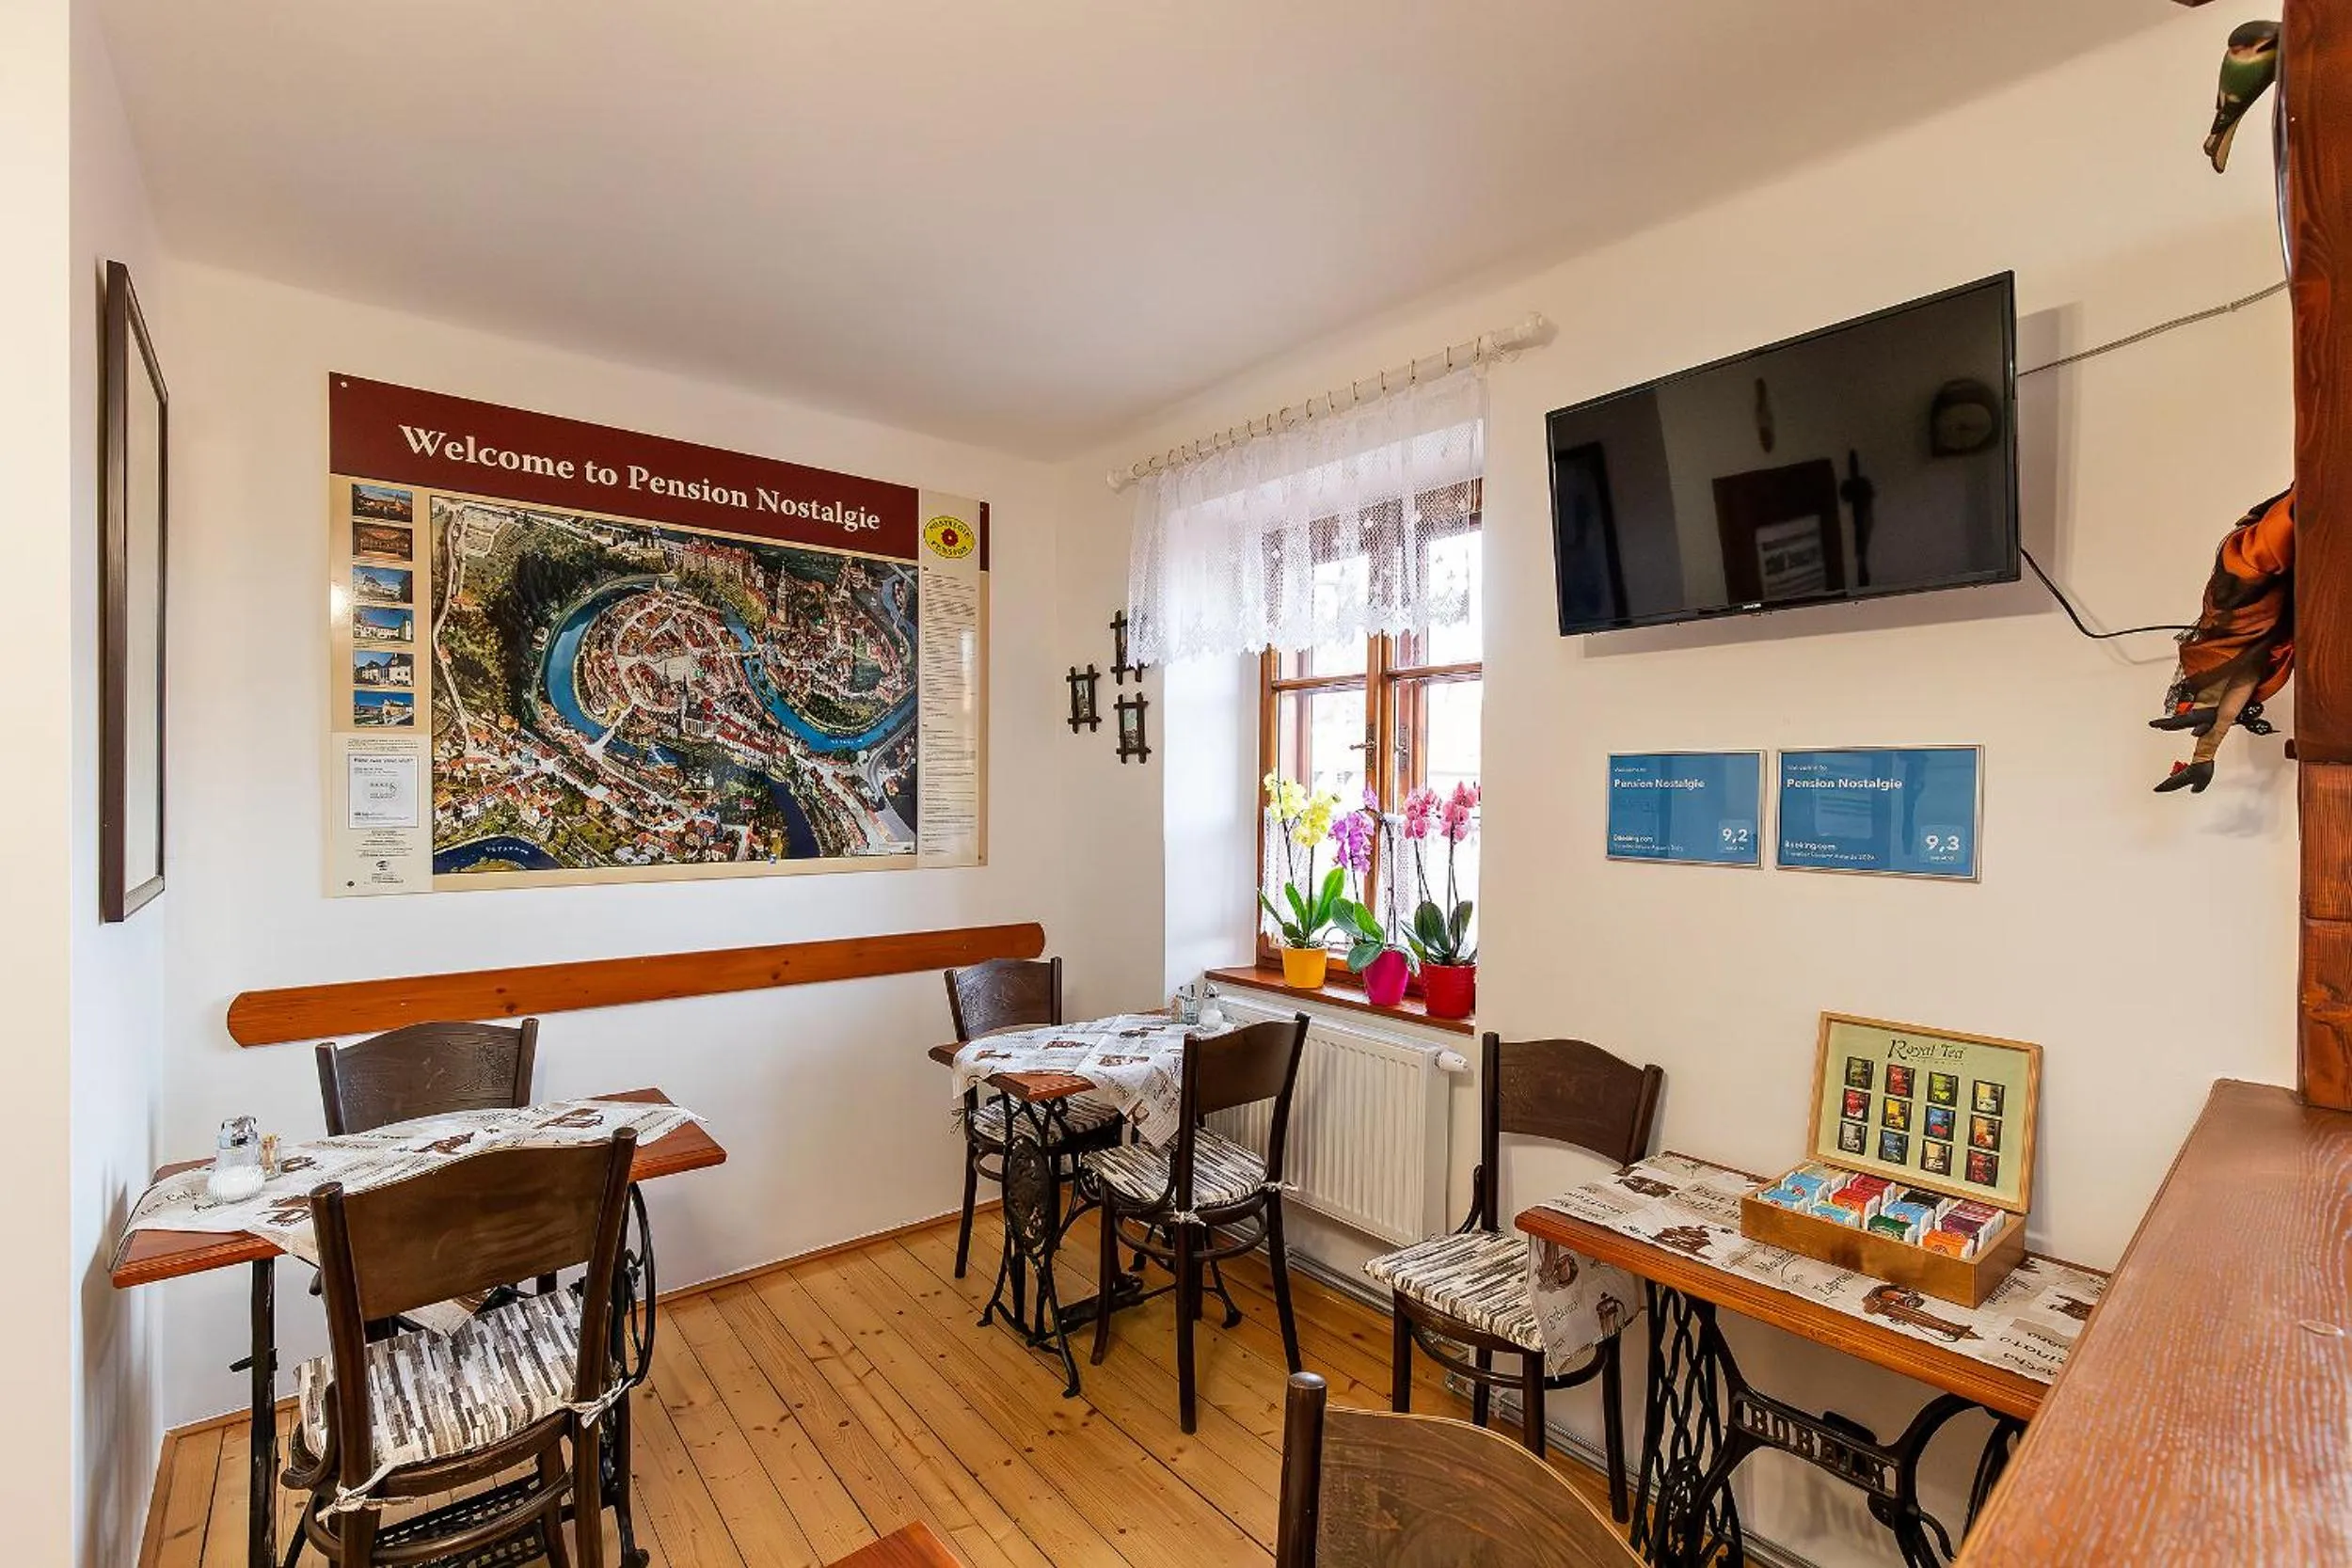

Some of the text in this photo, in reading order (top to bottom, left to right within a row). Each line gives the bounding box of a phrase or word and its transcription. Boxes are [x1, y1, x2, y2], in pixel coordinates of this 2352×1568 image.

[398, 424, 881, 532] Welcome to Pension Nostalgie
[1655, 779, 1706, 791] Nostalgie
[1786, 778, 1903, 791] Pension Nostalgie
[1723, 828, 1748, 844] 9,2
[1926, 834, 1960, 852] 9,3
[1887, 1038, 1965, 1061] Royal Tea
